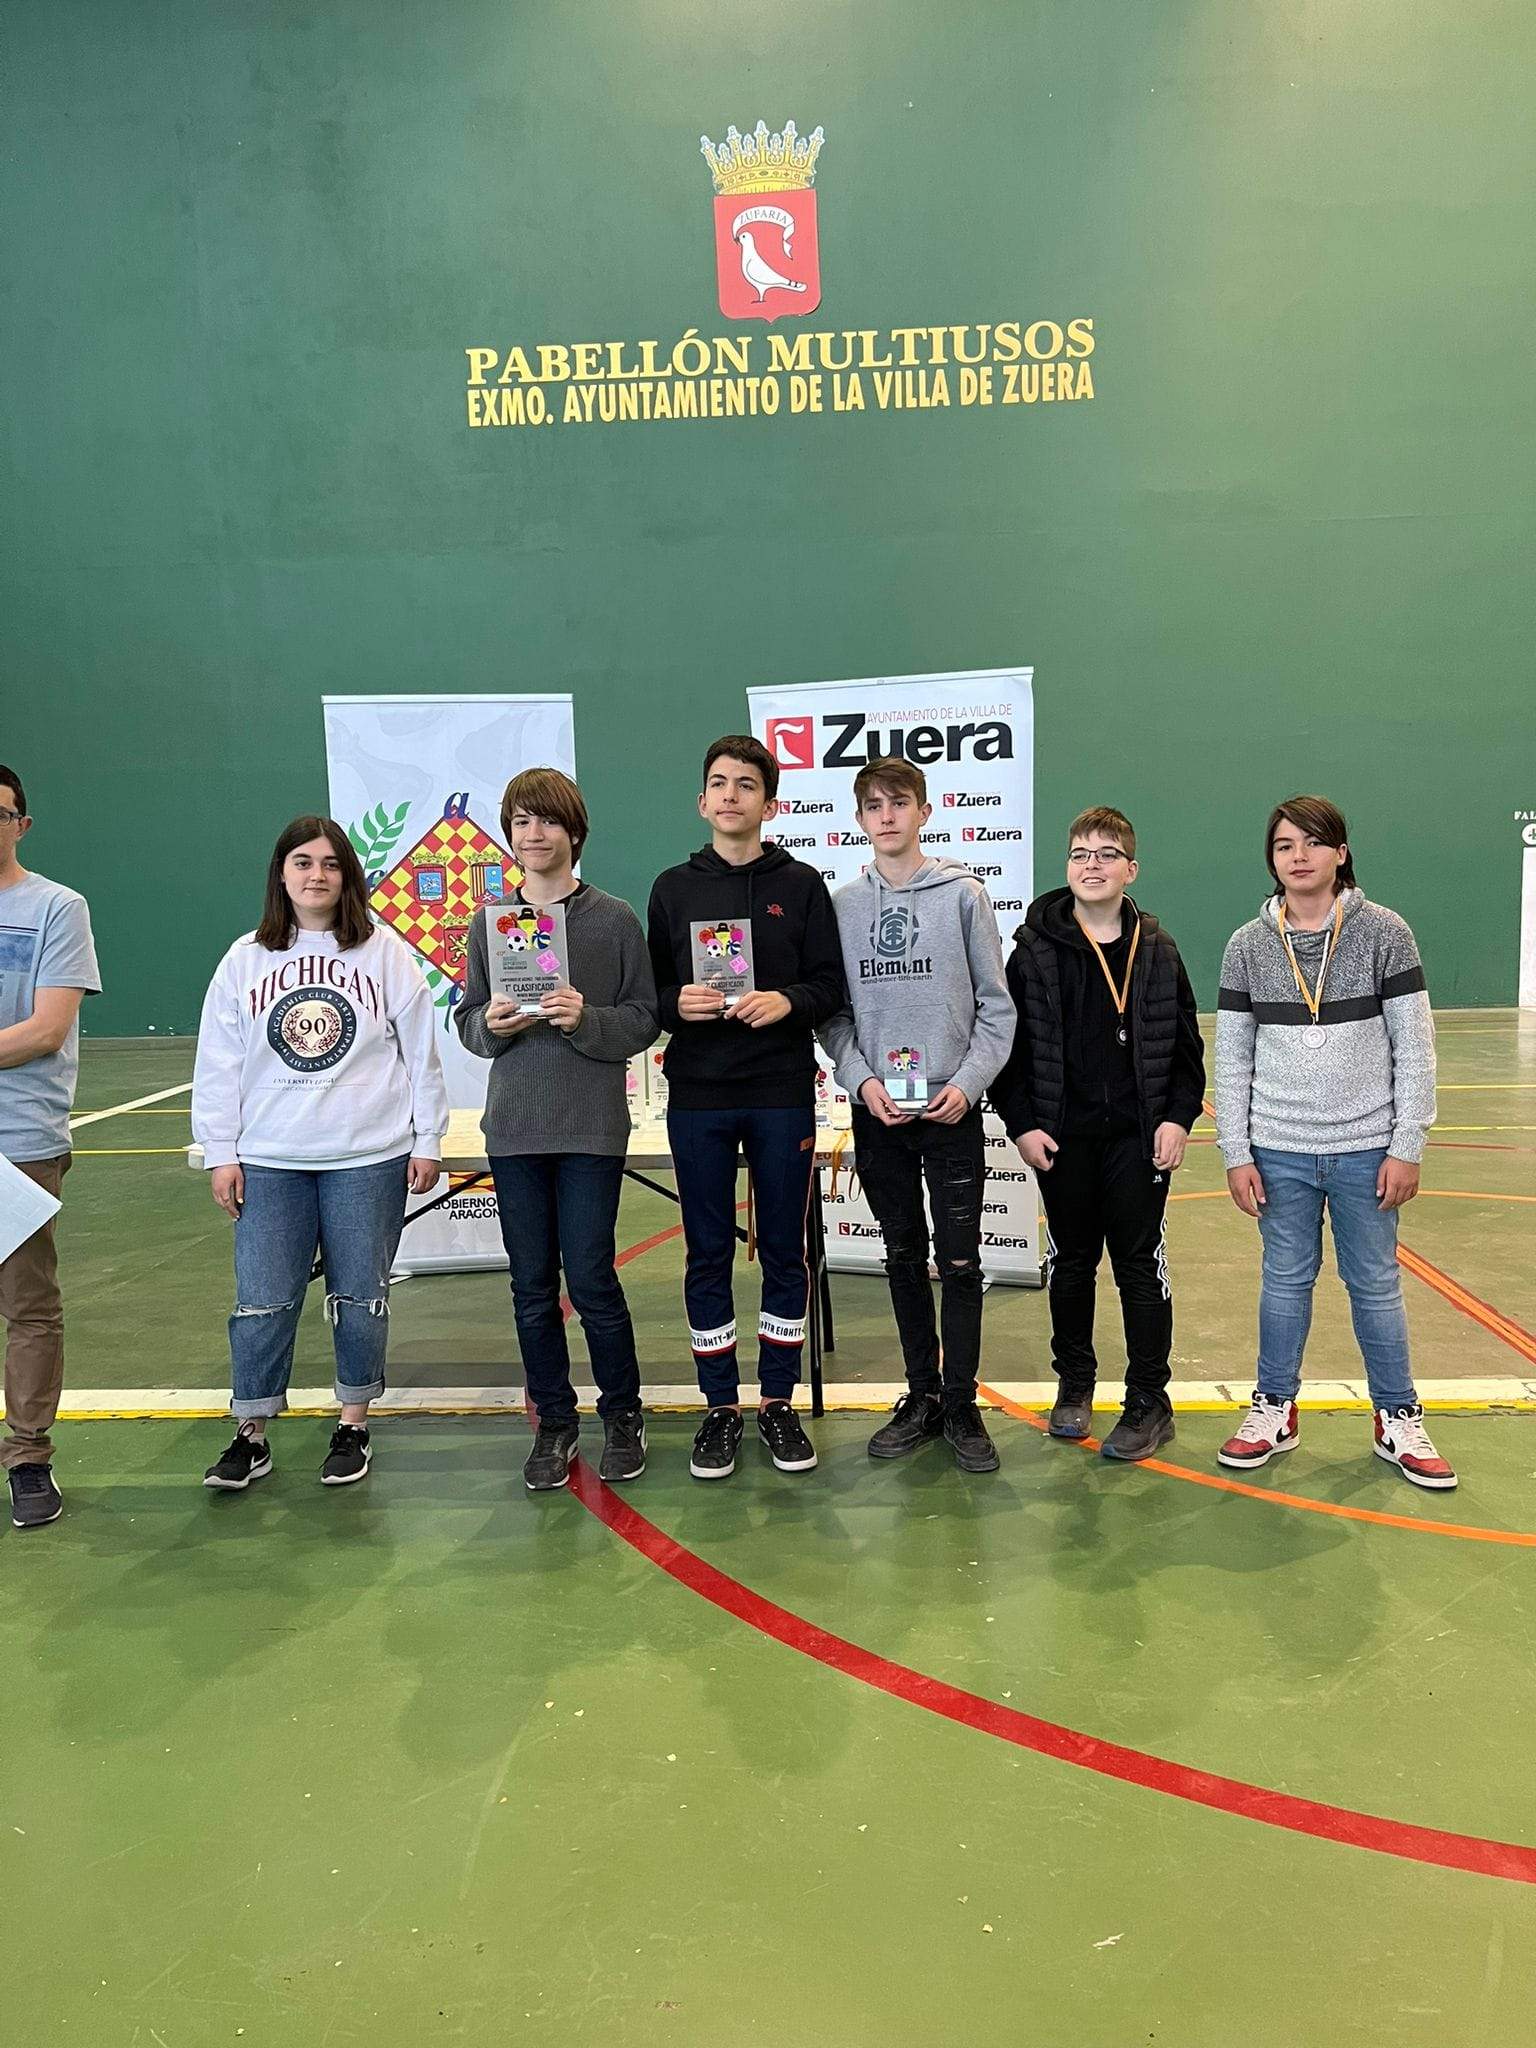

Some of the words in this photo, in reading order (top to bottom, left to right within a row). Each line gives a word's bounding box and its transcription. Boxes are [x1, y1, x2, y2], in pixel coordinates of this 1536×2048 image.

[465, 328, 752, 385] PABELLÓN
[766, 318, 1096, 372] MULTIUSOS
[467, 386, 554, 427] EXMO.
[563, 376, 780, 424] AYUNTAMIENTO
[790, 374, 823, 414] DE
[833, 372, 865, 412] LA
[872, 368, 950, 410] VILLA
[960, 366, 993, 406] DE
[1002, 361, 1095, 404] ZUERA
[867, 708, 938, 724] AYUNTAMIENTO
[941, 706, 953, 720] DE
[955, 706, 967, 719] LA
[970, 704, 996, 718] VILLA
[999, 703, 1013, 716] DE
[823, 713, 1014, 768] Zuera
[792, 800, 834, 814] Zuera
[956, 793, 1002, 807] Zuera
[775, 834, 817, 848] Zuera
[841, 832, 872, 845] Zue
[919, 832, 951, 843] uera
[976, 827, 1022, 841] Zuera
[964, 863, 1002, 876] uera
[993, 900, 1023, 911] era
[249, 955, 380, 1020] MICHIGAN
[513, 982, 555, 992] CLASIFICADO
[308, 991, 333, 1000] CLUB
[299, 1017, 327, 1036] 90
[984, 1138, 1006, 1148] era
[984, 1166, 1027, 1182] Zuera
[449, 1207, 500, 1221] ARAGON
[983, 1202, 1008, 1214] era
[851, 1223, 883, 1238] Zuer
[983, 1231, 1028, 1249] Zuera
